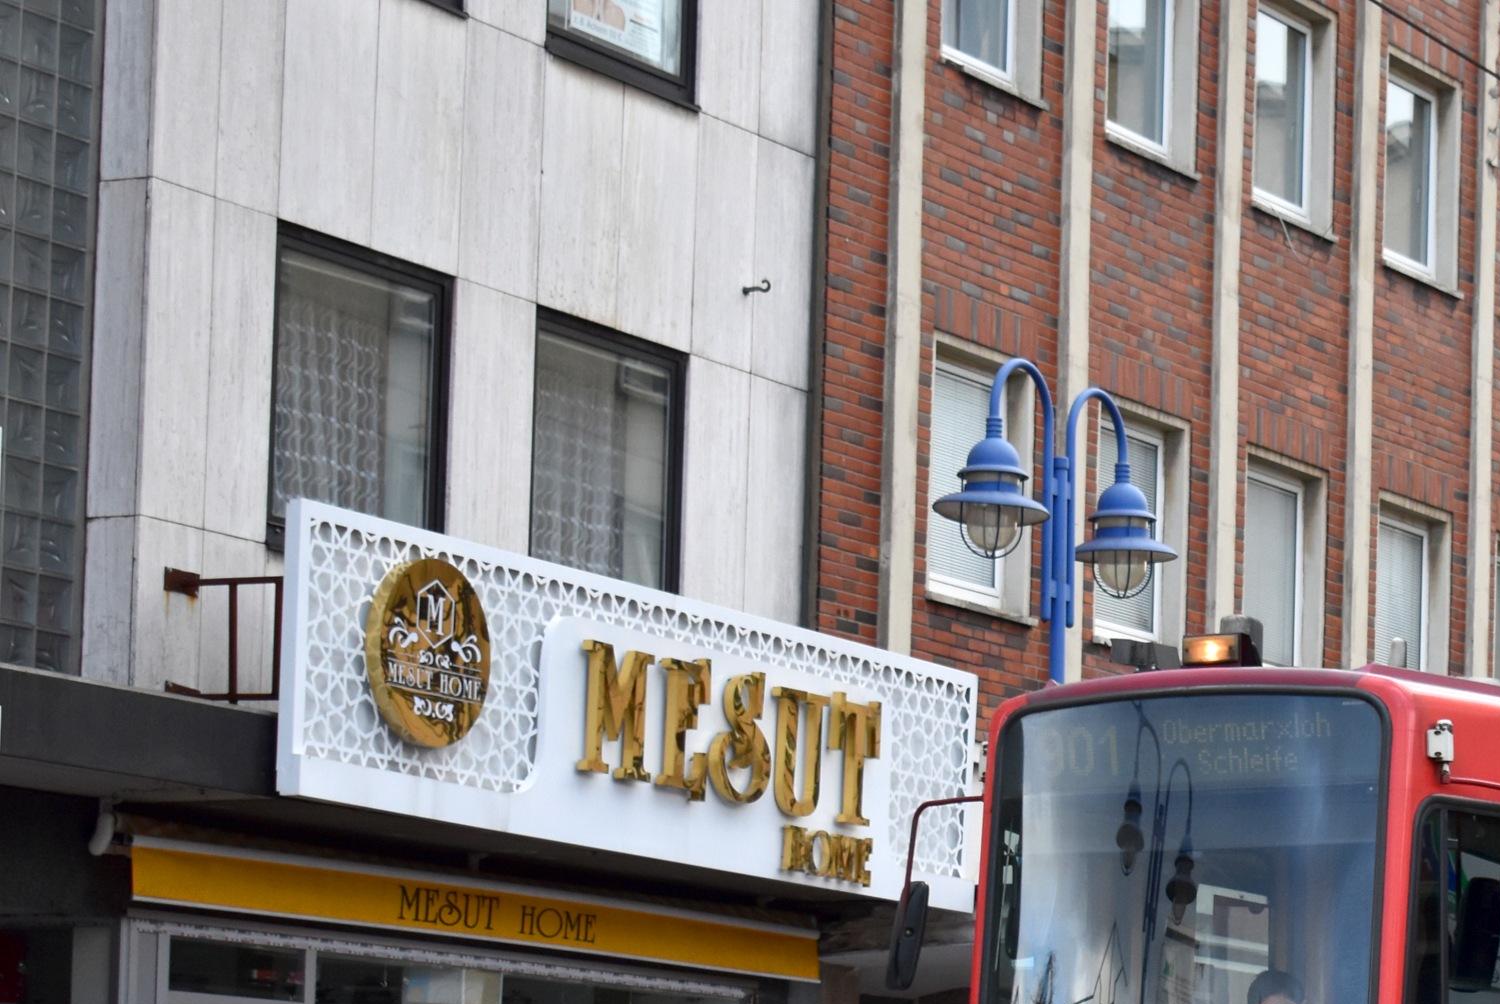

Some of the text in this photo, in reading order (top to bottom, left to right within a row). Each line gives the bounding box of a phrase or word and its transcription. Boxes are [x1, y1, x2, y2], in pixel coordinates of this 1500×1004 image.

[425, 594, 446, 636] M
[388, 661, 482, 701] MESUT HOME
[576, 639, 882, 827] MESUT
[1045, 724, 1120, 777] 901
[1198, 749, 1299, 775] Schleife
[780, 824, 873, 887] HOME
[397, 884, 597, 944] MESUT HOME
